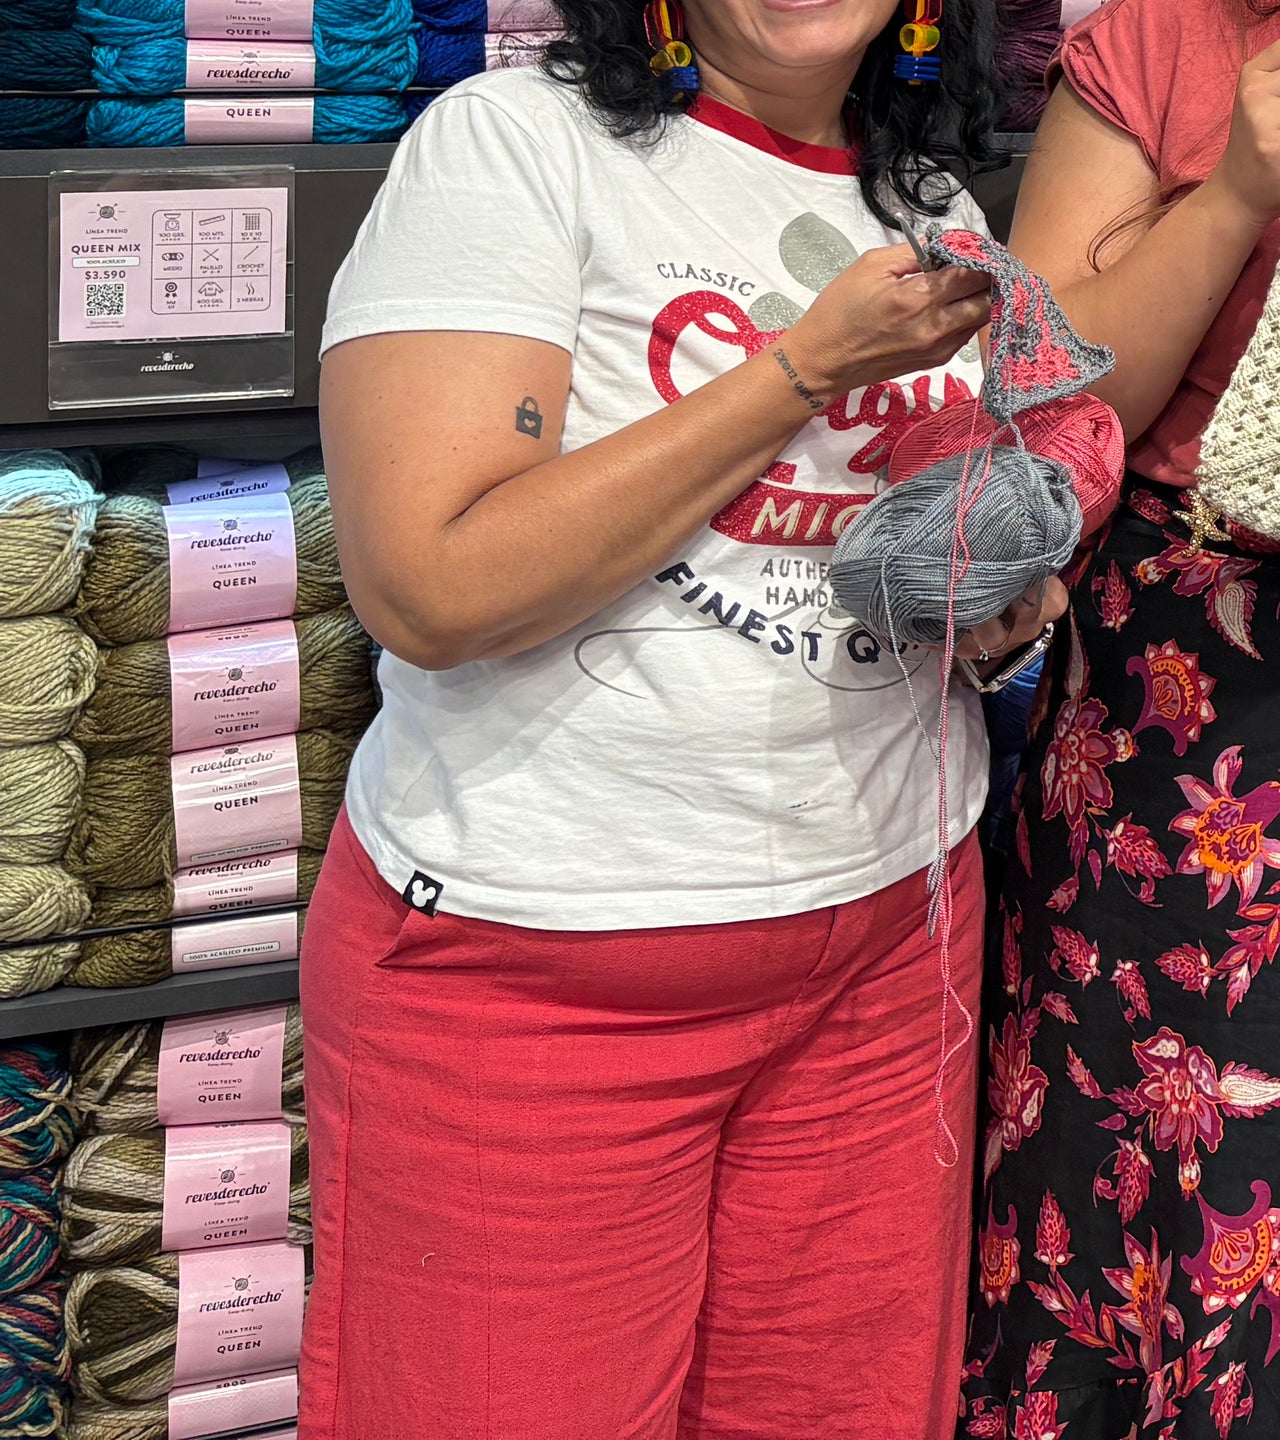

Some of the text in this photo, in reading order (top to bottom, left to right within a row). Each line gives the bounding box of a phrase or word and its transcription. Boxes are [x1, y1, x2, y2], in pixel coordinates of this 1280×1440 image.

[206, 67, 291, 80] revesderecho
[226, 107, 271, 117] QUEEN
[72, 244, 140, 255] QUEEN MIX
[85, 270, 125, 280] $3.590
[656, 262, 756, 297] CLASSIC
[751, 497, 867, 540] MIC
[191, 531, 272, 550] revesderecho
[760, 559, 831, 581] AUTHE
[213, 576, 257, 590] QUEEN
[766, 586, 828, 608] HAND
[654, 561, 821, 661] FINEST
[194, 680, 277, 703] revesderecho
[215, 723, 259, 735] QUEEN
[190, 751, 273, 775] revesderecho
[214, 796, 259, 811] QUEEN
[180, 1048, 260, 1063] revesderecho
[198, 1093, 241, 1103] QUEEN
[186, 1183, 267, 1204] revesderecho
[204, 1228, 247, 1241] QUEEN
[199, 1291, 281, 1314] revesderecho
[217, 1340, 261, 1354] QUEEN
